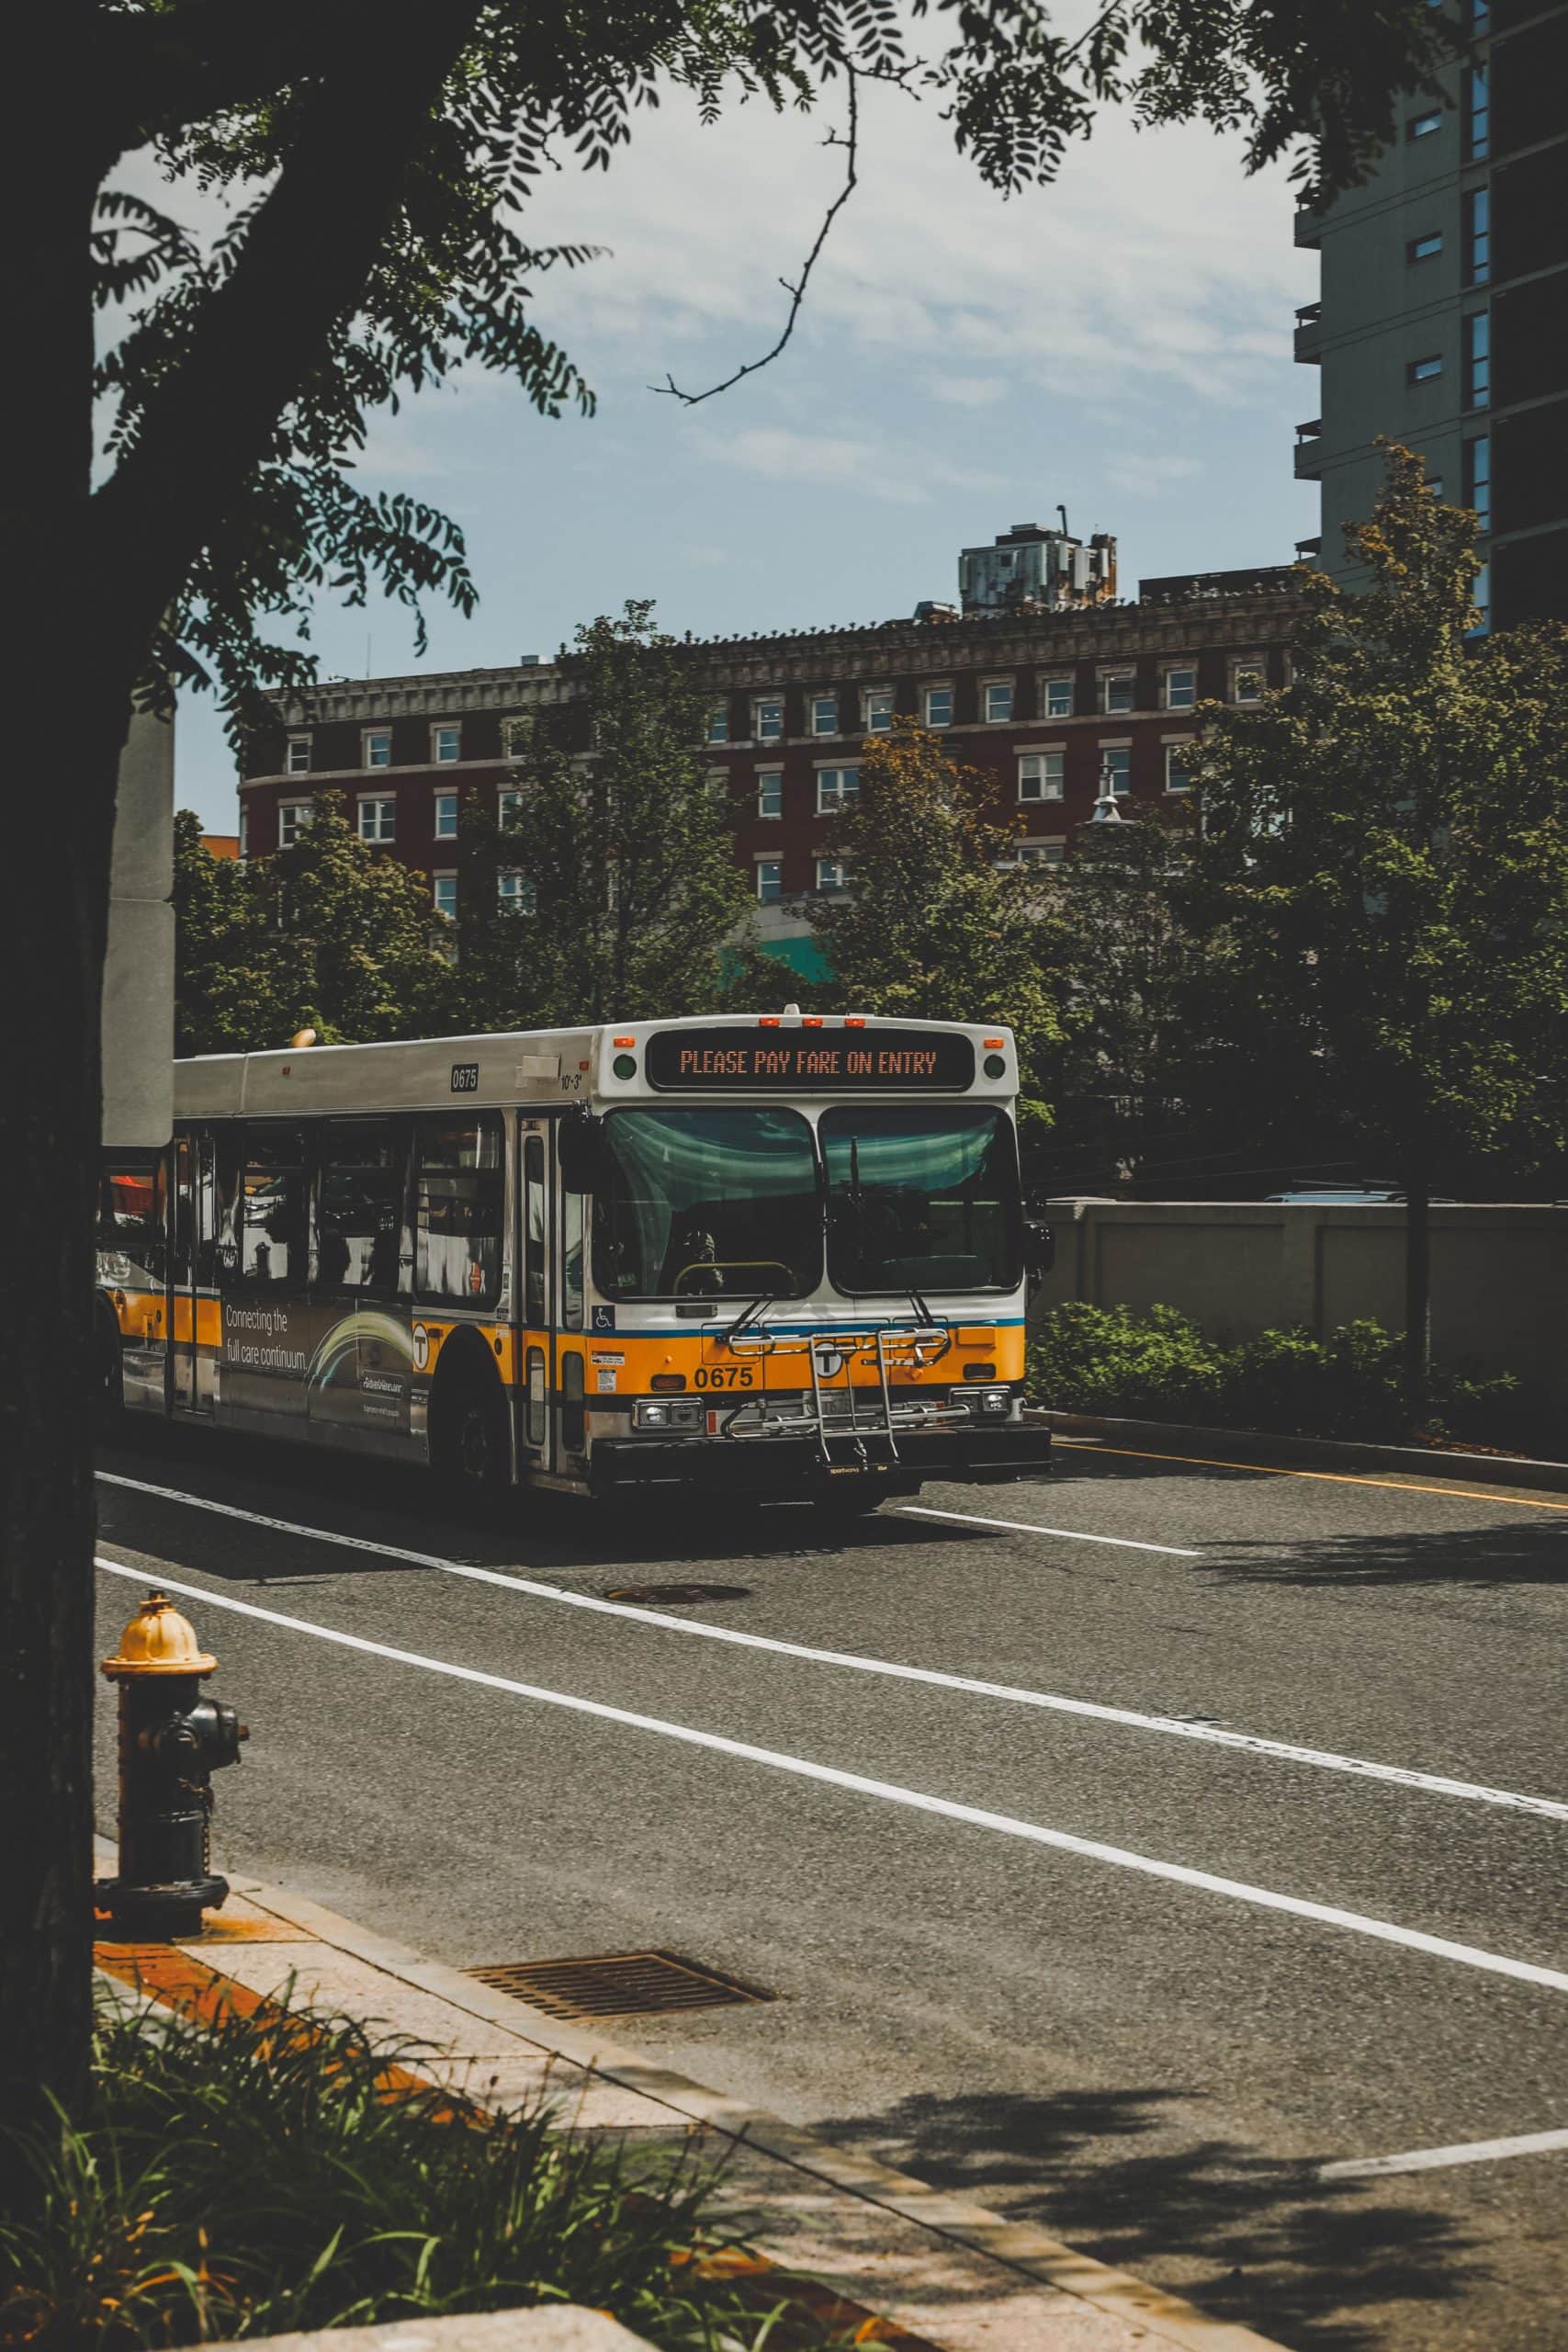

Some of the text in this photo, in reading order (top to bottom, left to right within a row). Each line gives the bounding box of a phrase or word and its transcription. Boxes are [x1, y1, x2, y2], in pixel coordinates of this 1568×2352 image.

[680, 1051, 937, 1073] PLEASE PAY FARE ON ENTRY
[452, 1069, 477, 1090] 0675
[226, 1304, 288, 1336] Connecting the
[227, 1338, 308, 1371] full care continuum.
[415, 1336, 426, 1363] T
[817, 1351, 838, 1373] T
[694, 1367, 753, 1388] 0675
